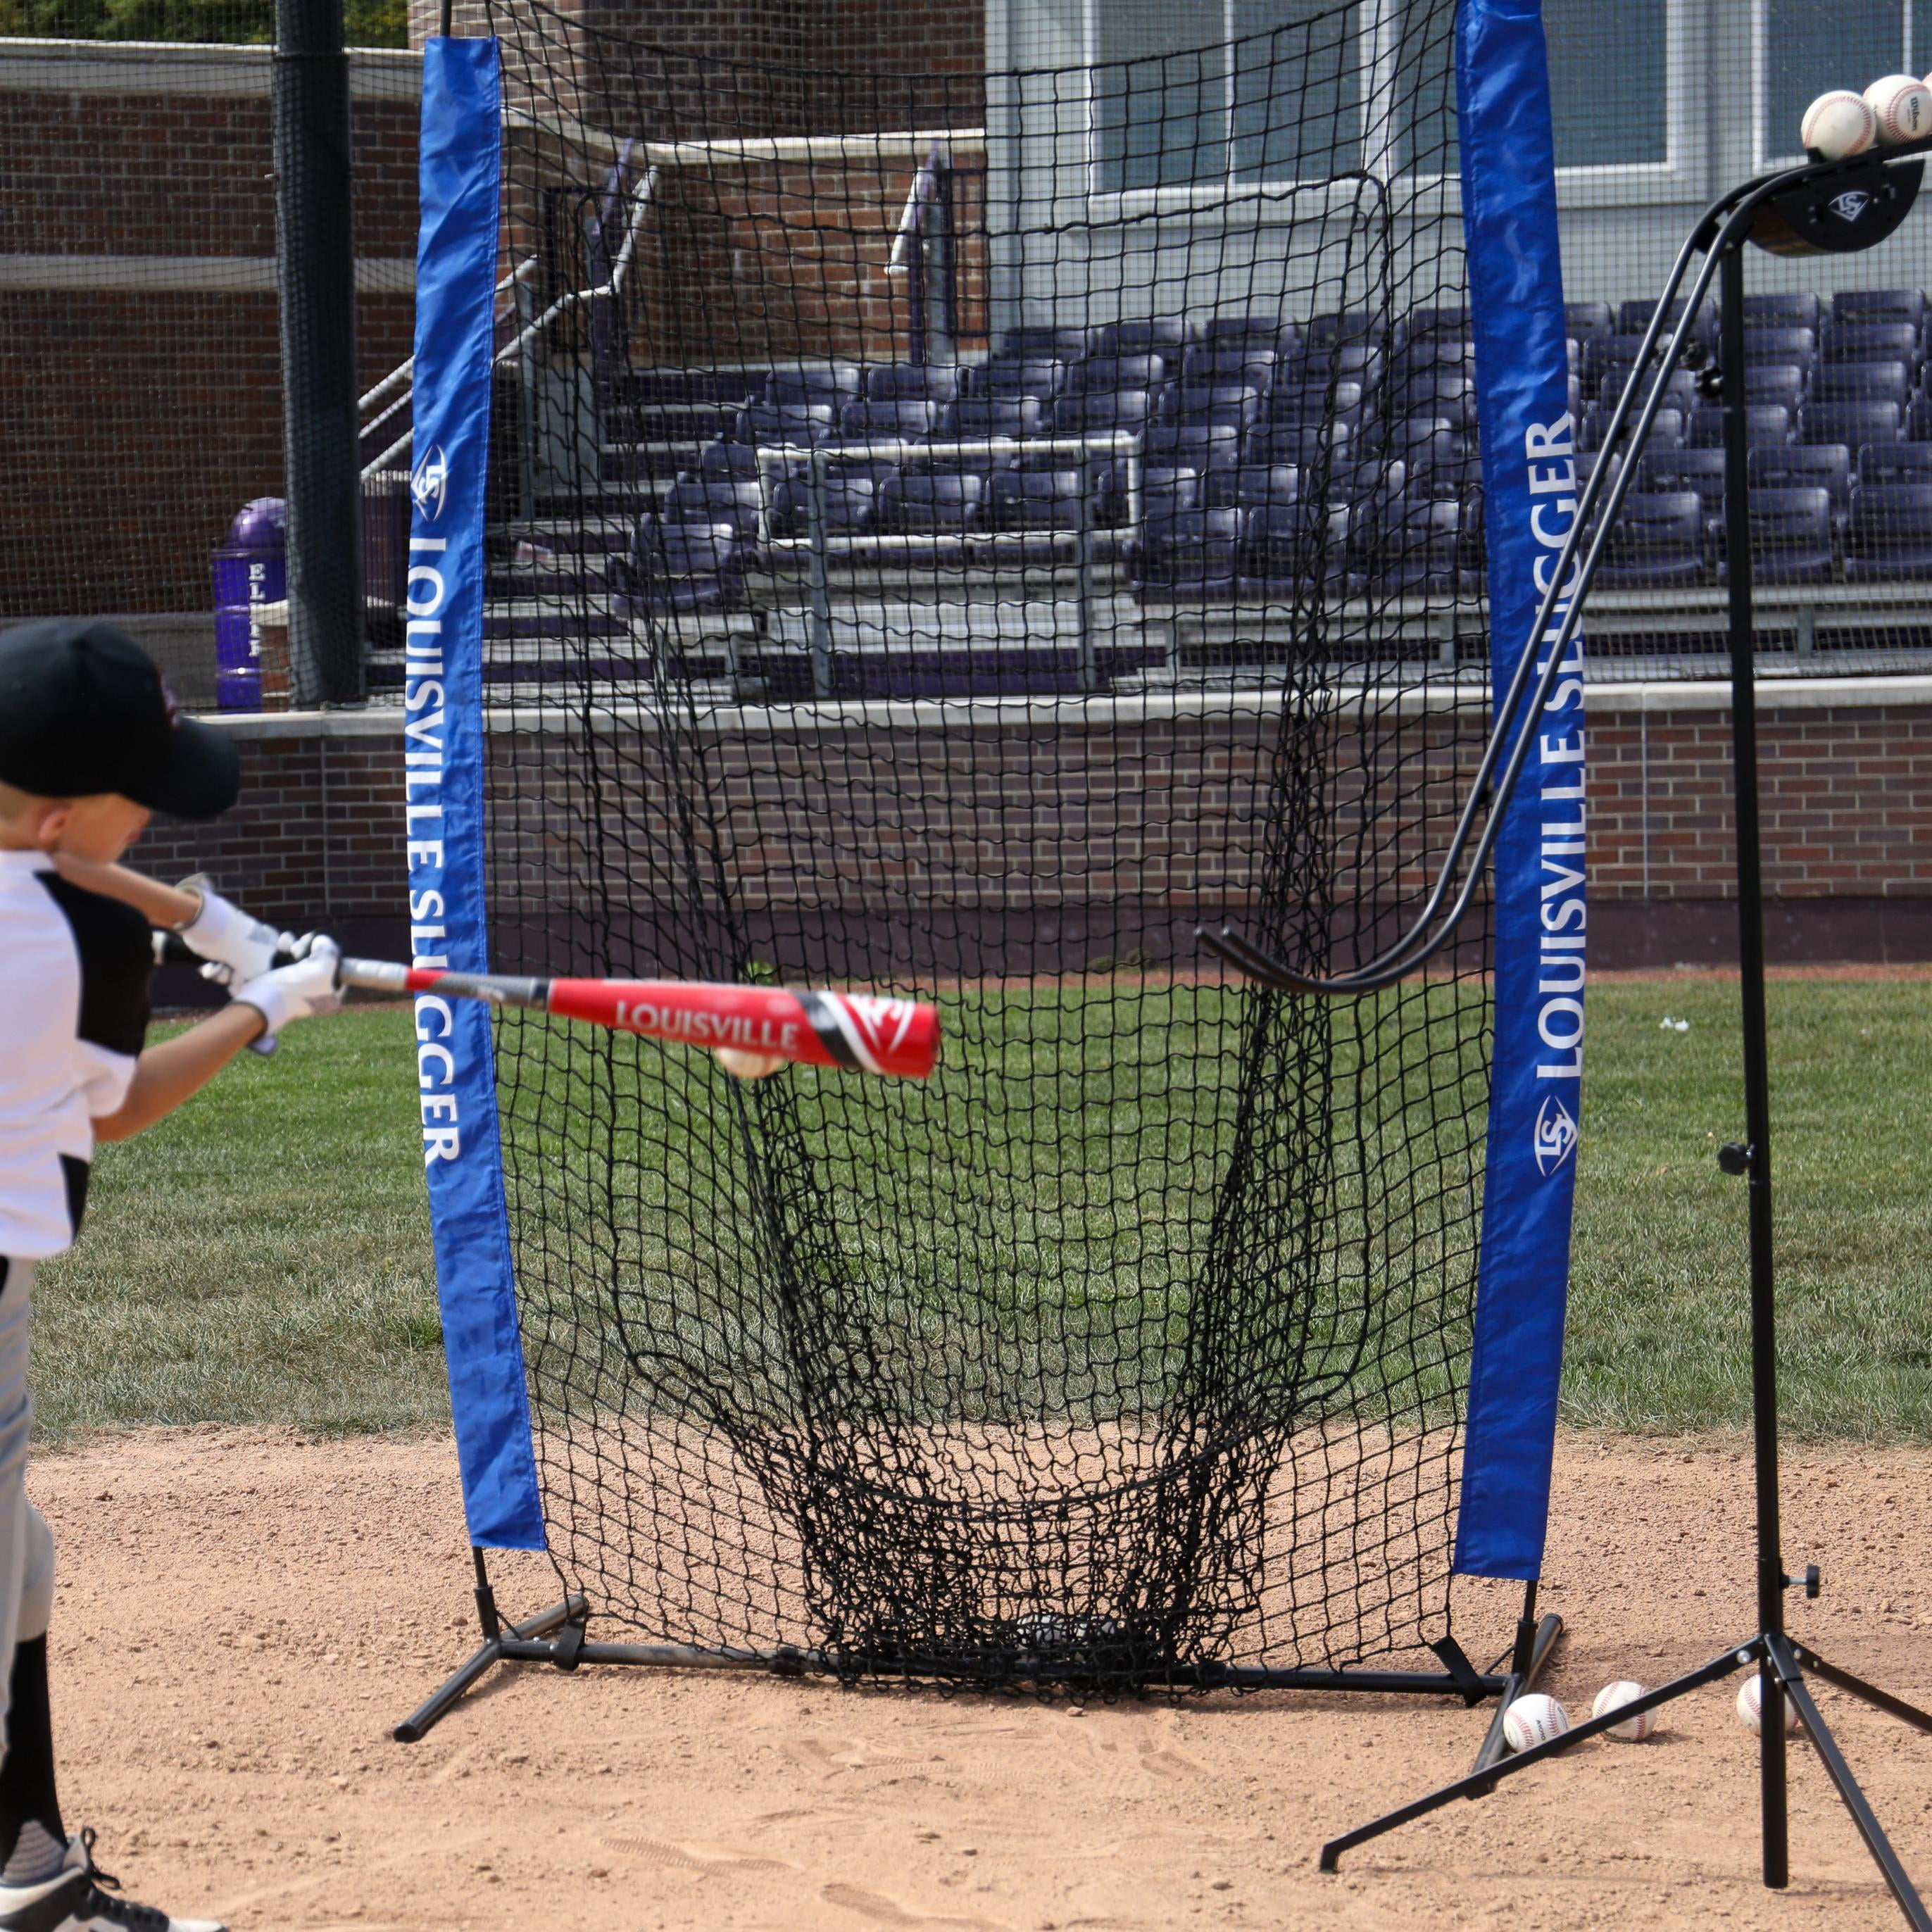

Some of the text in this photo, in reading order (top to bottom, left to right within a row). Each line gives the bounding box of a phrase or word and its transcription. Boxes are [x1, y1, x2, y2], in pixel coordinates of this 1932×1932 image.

[1910, 96, 1919, 131] Wilson
[406, 537, 447, 870] LOUISVILLE
[1536, 729, 1586, 1078] LOUISVILLE
[615, 1000, 800, 1050] LOUISVILLE
